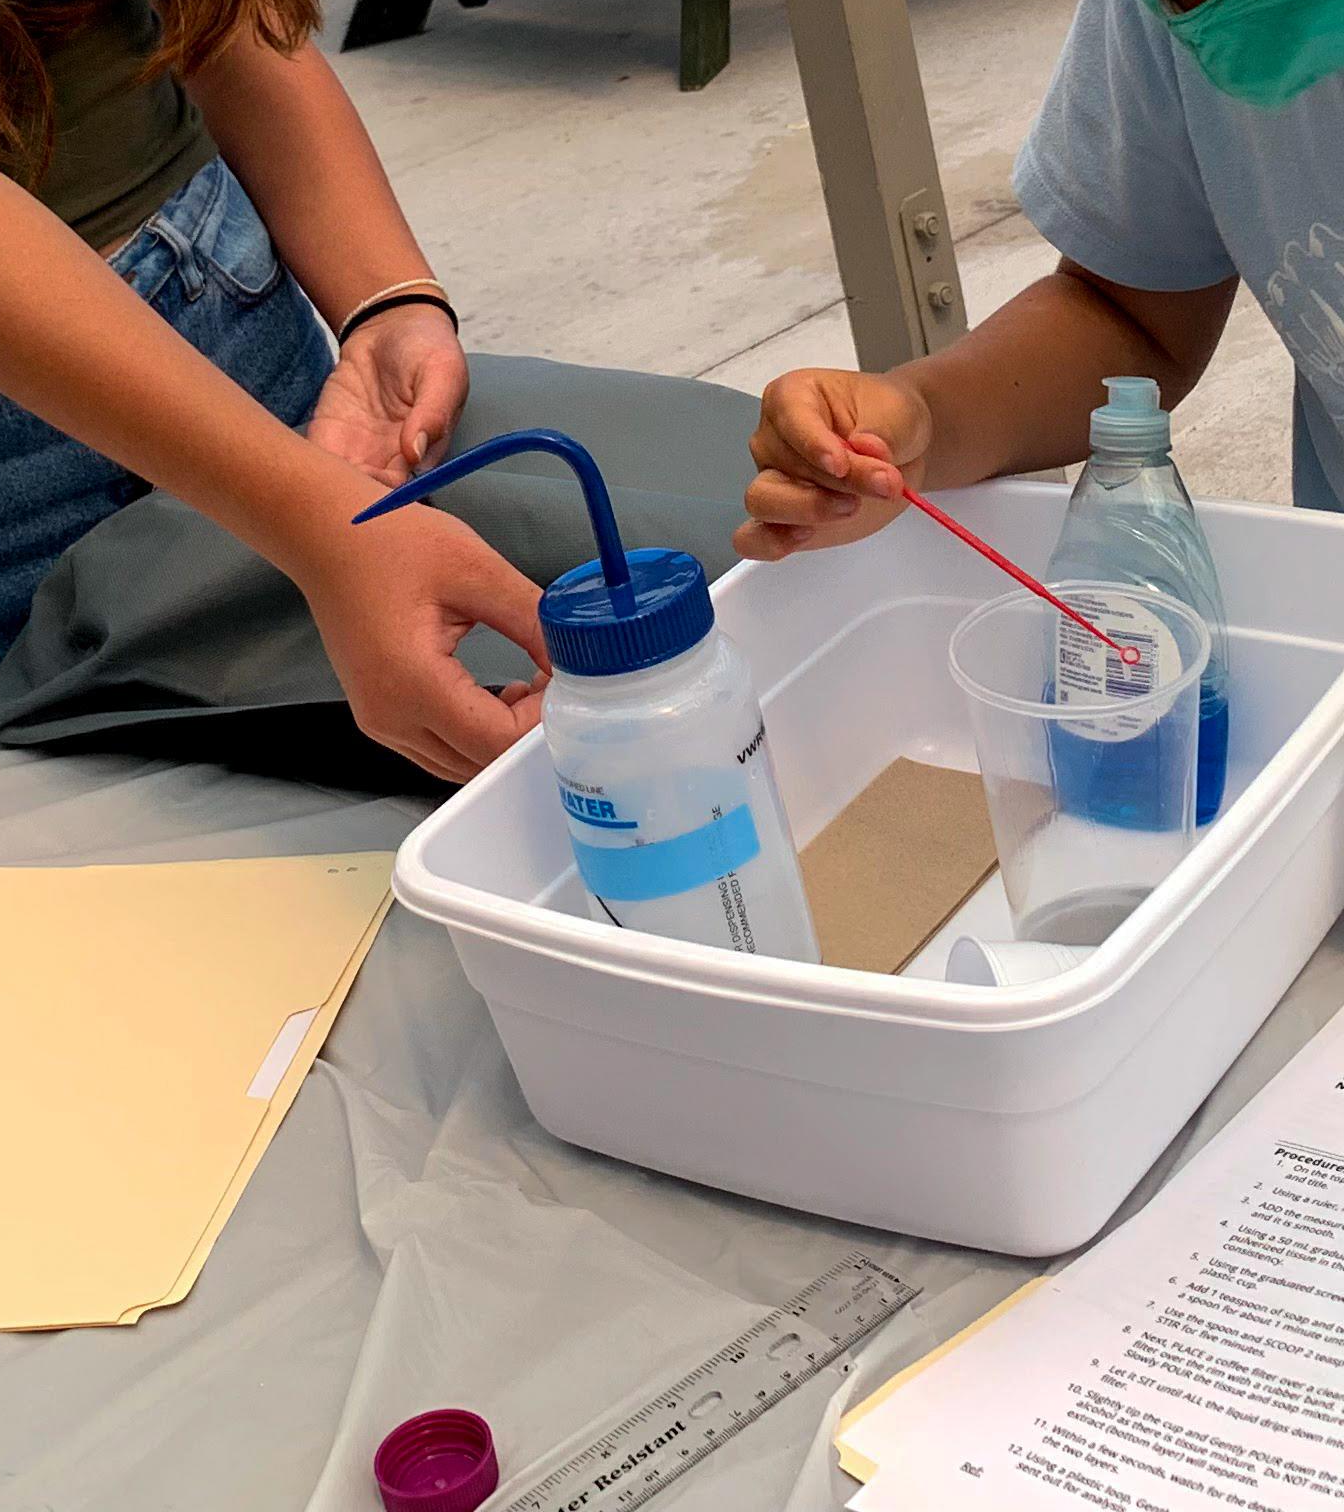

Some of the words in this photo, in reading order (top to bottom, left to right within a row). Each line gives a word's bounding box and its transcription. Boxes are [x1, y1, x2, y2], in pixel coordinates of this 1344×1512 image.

[1272, 1187, 1303, 1202] Using
[1250, 1211, 1274, 1222] and
[1272, 1216, 1283, 1224] it
[1282, 1219, 1294, 1228] is
[1292, 1223, 1335, 1239] smooth.
[1199, 1267, 1236, 1283] plastic
[1222, 1243, 1284, 1266] consistency.
[1155, 1315, 1181, 1329] STIR
[1180, 1323, 1199, 1335] for
[1198, 1329, 1219, 1343] five
[1219, 1338, 1265, 1358] minutes.
[1164, 1306, 1185, 1319] Use
[1185, 1314, 1205, 1326] the
[1205, 1321, 1240, 1337] spoon
[1239, 1332, 1265, 1344] and
[1263, 1338, 1304, 1354] SCOOP
[1303, 1349, 1314, 1359] 2
[593, 1419, 687, 1492] Resistant
[1041, 1435, 1061, 1449] the
[1061, 1444, 1084, 1458] two
[1084, 1452, 1119, 1474] layers.
[1066, 1410, 1106, 1430] extract
[1104, 1424, 1151, 1448] (bottom
[1151, 1442, 1186, 1462] layer)
[1185, 1456, 1208, 1469] will
[1206, 1464, 1258, 1488] separate.
[1084, 1390, 1125, 1412] Slightly
[1124, 1406, 1142, 1418] tip
[1142, 1412, 1162, 1425] the
[1162, 1421, 1184, 1434] cup
[1184, 1429, 1210, 1443] and
[1209, 1436, 1247, 1457] Gently
[1247, 1449, 1283, 1466] POUR
[1283, 1461, 1317, 1477] down
[1317, 1470, 1339, 1484] the
